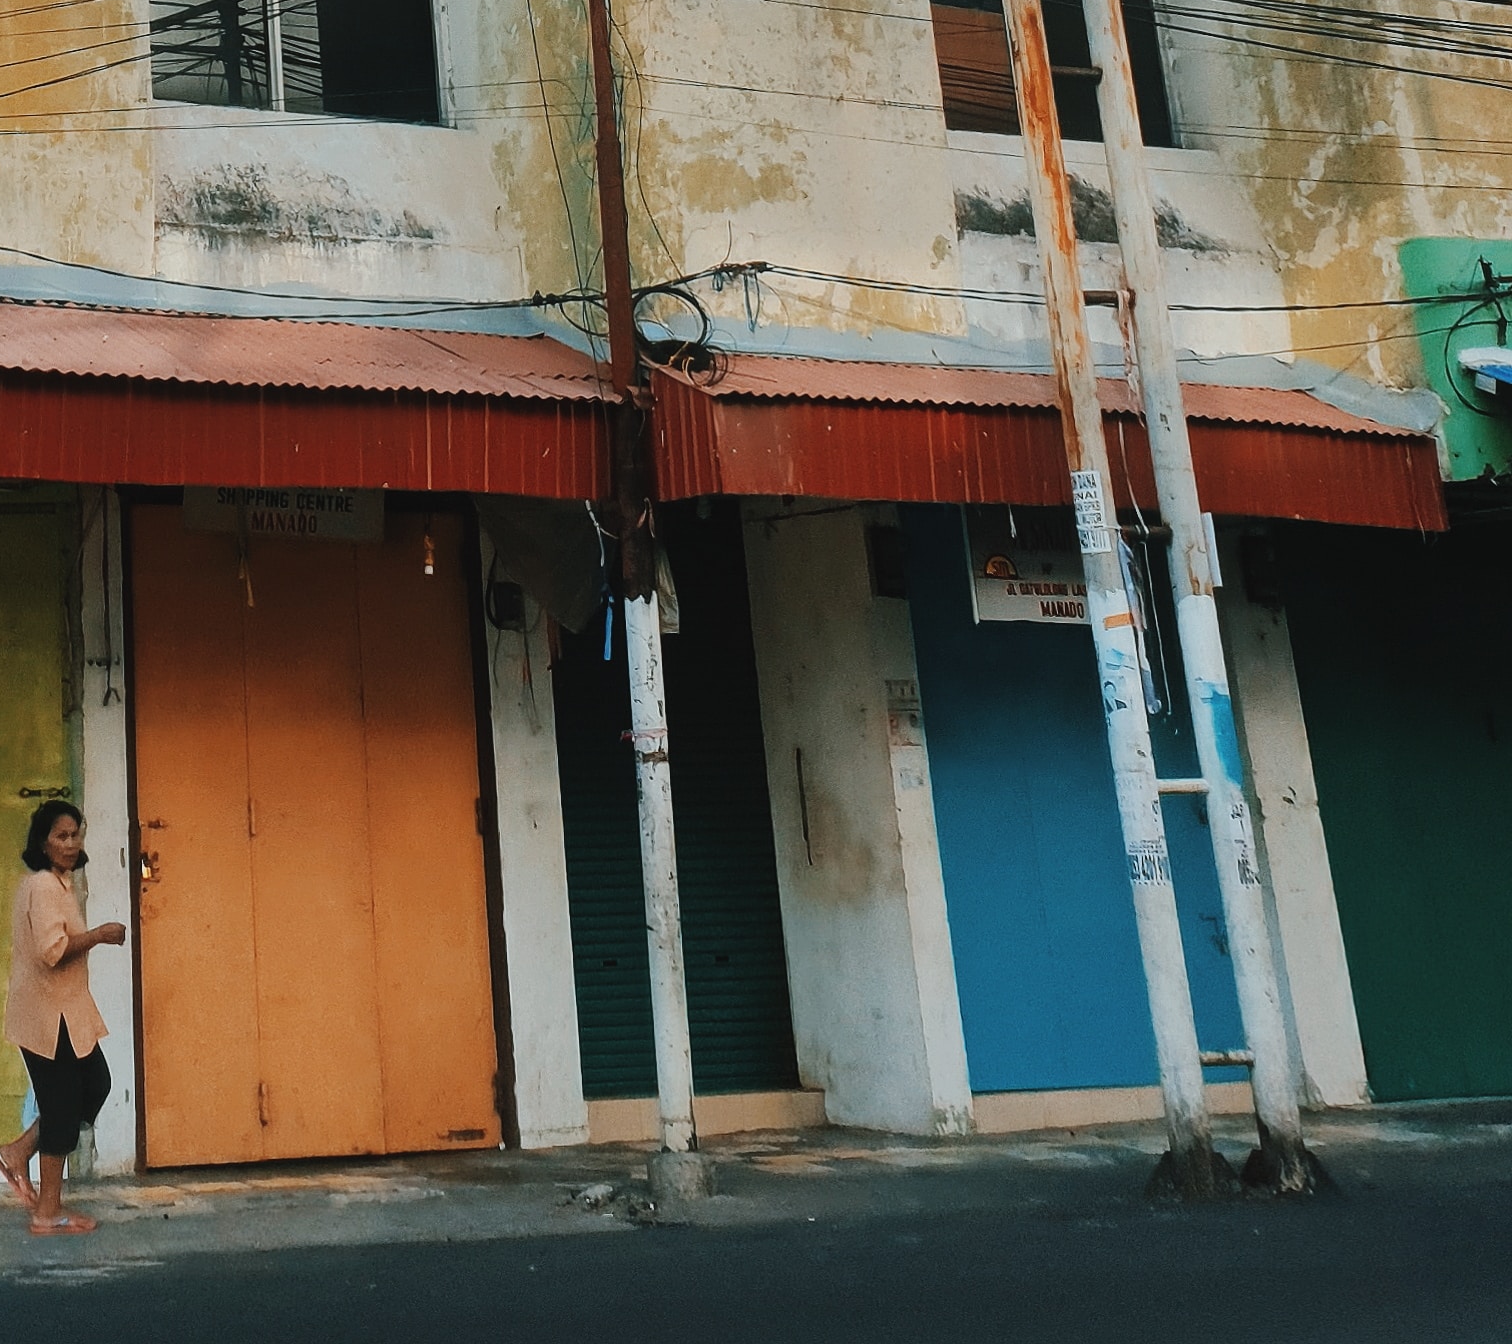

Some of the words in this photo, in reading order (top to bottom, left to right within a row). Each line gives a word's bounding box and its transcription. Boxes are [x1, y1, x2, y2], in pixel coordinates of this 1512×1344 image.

[217, 486, 289, 510] SHPPING
[296, 490, 354, 513] CENTRE
[251, 511, 318, 534] MANADO
[1040, 601, 1085, 618] MANADO
